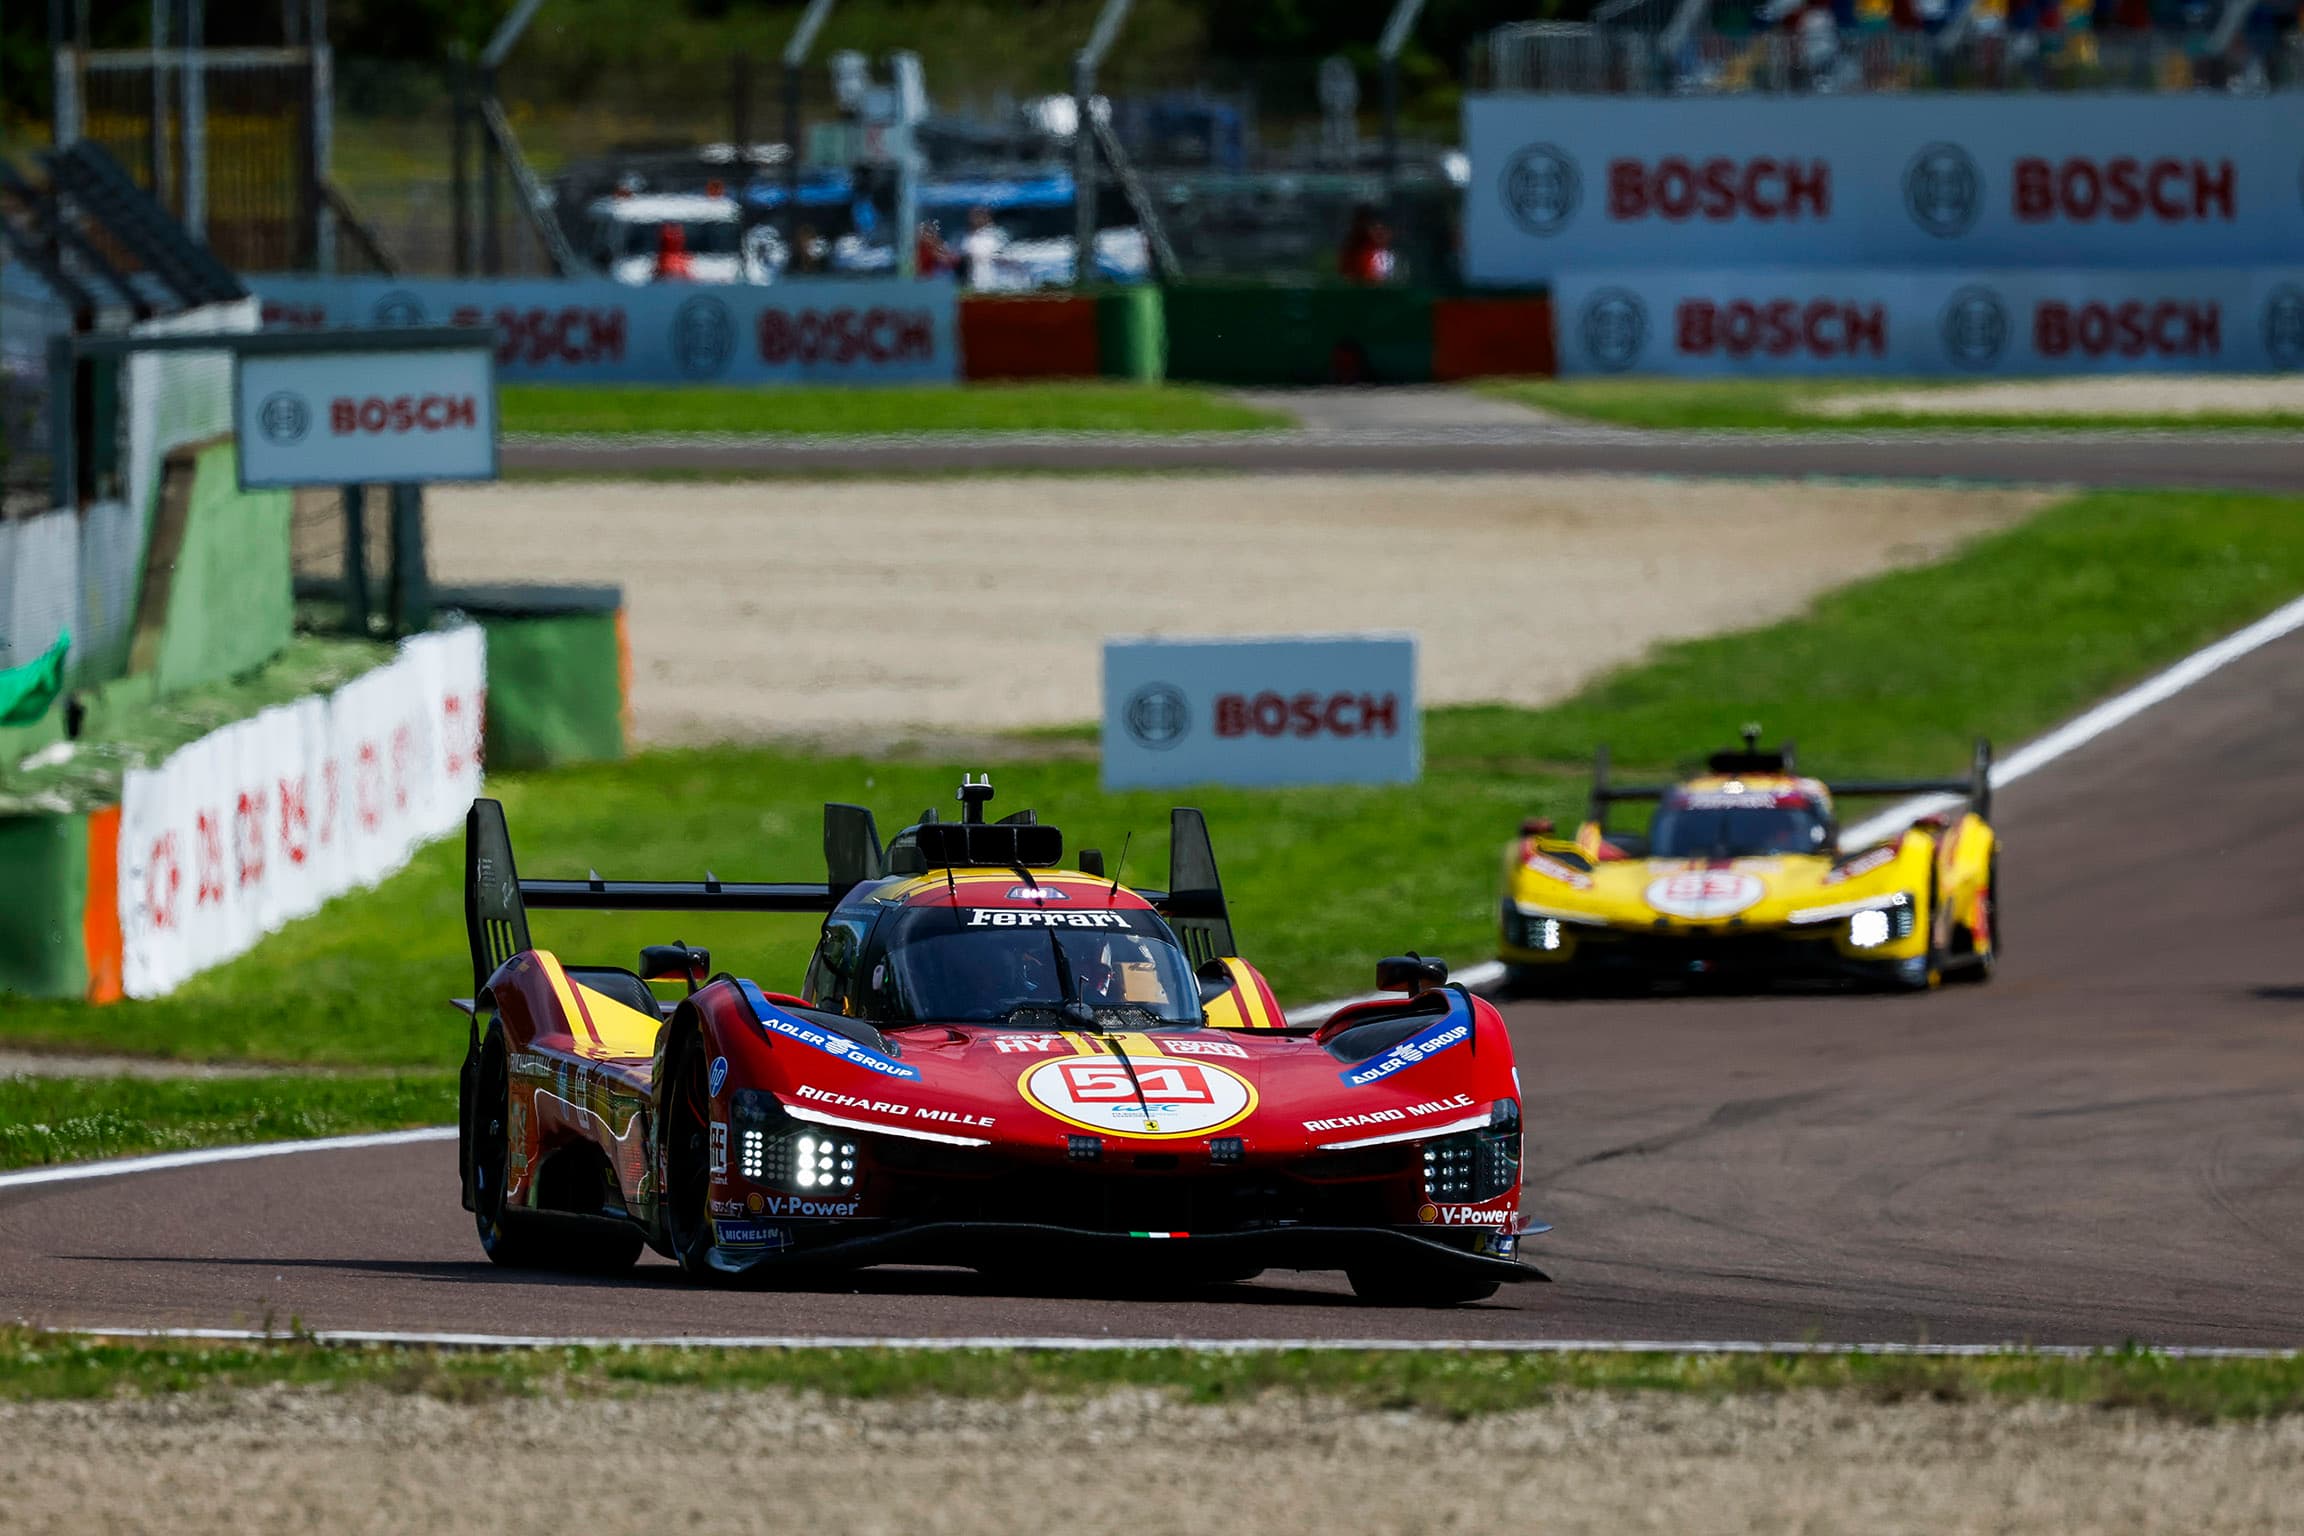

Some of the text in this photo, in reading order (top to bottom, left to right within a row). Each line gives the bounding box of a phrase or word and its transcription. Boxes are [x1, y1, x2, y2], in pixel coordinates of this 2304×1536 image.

[1607, 157, 1831, 221] BOSCH
[2012, 157, 2238, 222] BOSCH
[758, 307, 935, 366] BOSCH
[1676, 300, 1888, 357] BOSCH
[2035, 300, 2222, 357] BOSCH
[329, 394, 477, 435] BOSCH
[1214, 691, 1398, 739] BOSCH
[966, 908, 1132, 928] Ferrari
[762, 1018, 913, 1078] ADLER GROUP
[1352, 1026, 1469, 1085] ADLER GROUP
[1069, 1067, 1206, 1099] 51
[796, 1085, 996, 1128] RICHARD MILLE
[1302, 1093, 1475, 1132] RICHARD MILLE
[766, 1195, 858, 1216] V-Power
[1441, 1206, 1509, 1224] V-Power
[725, 1228, 779, 1241] MICHELIN
